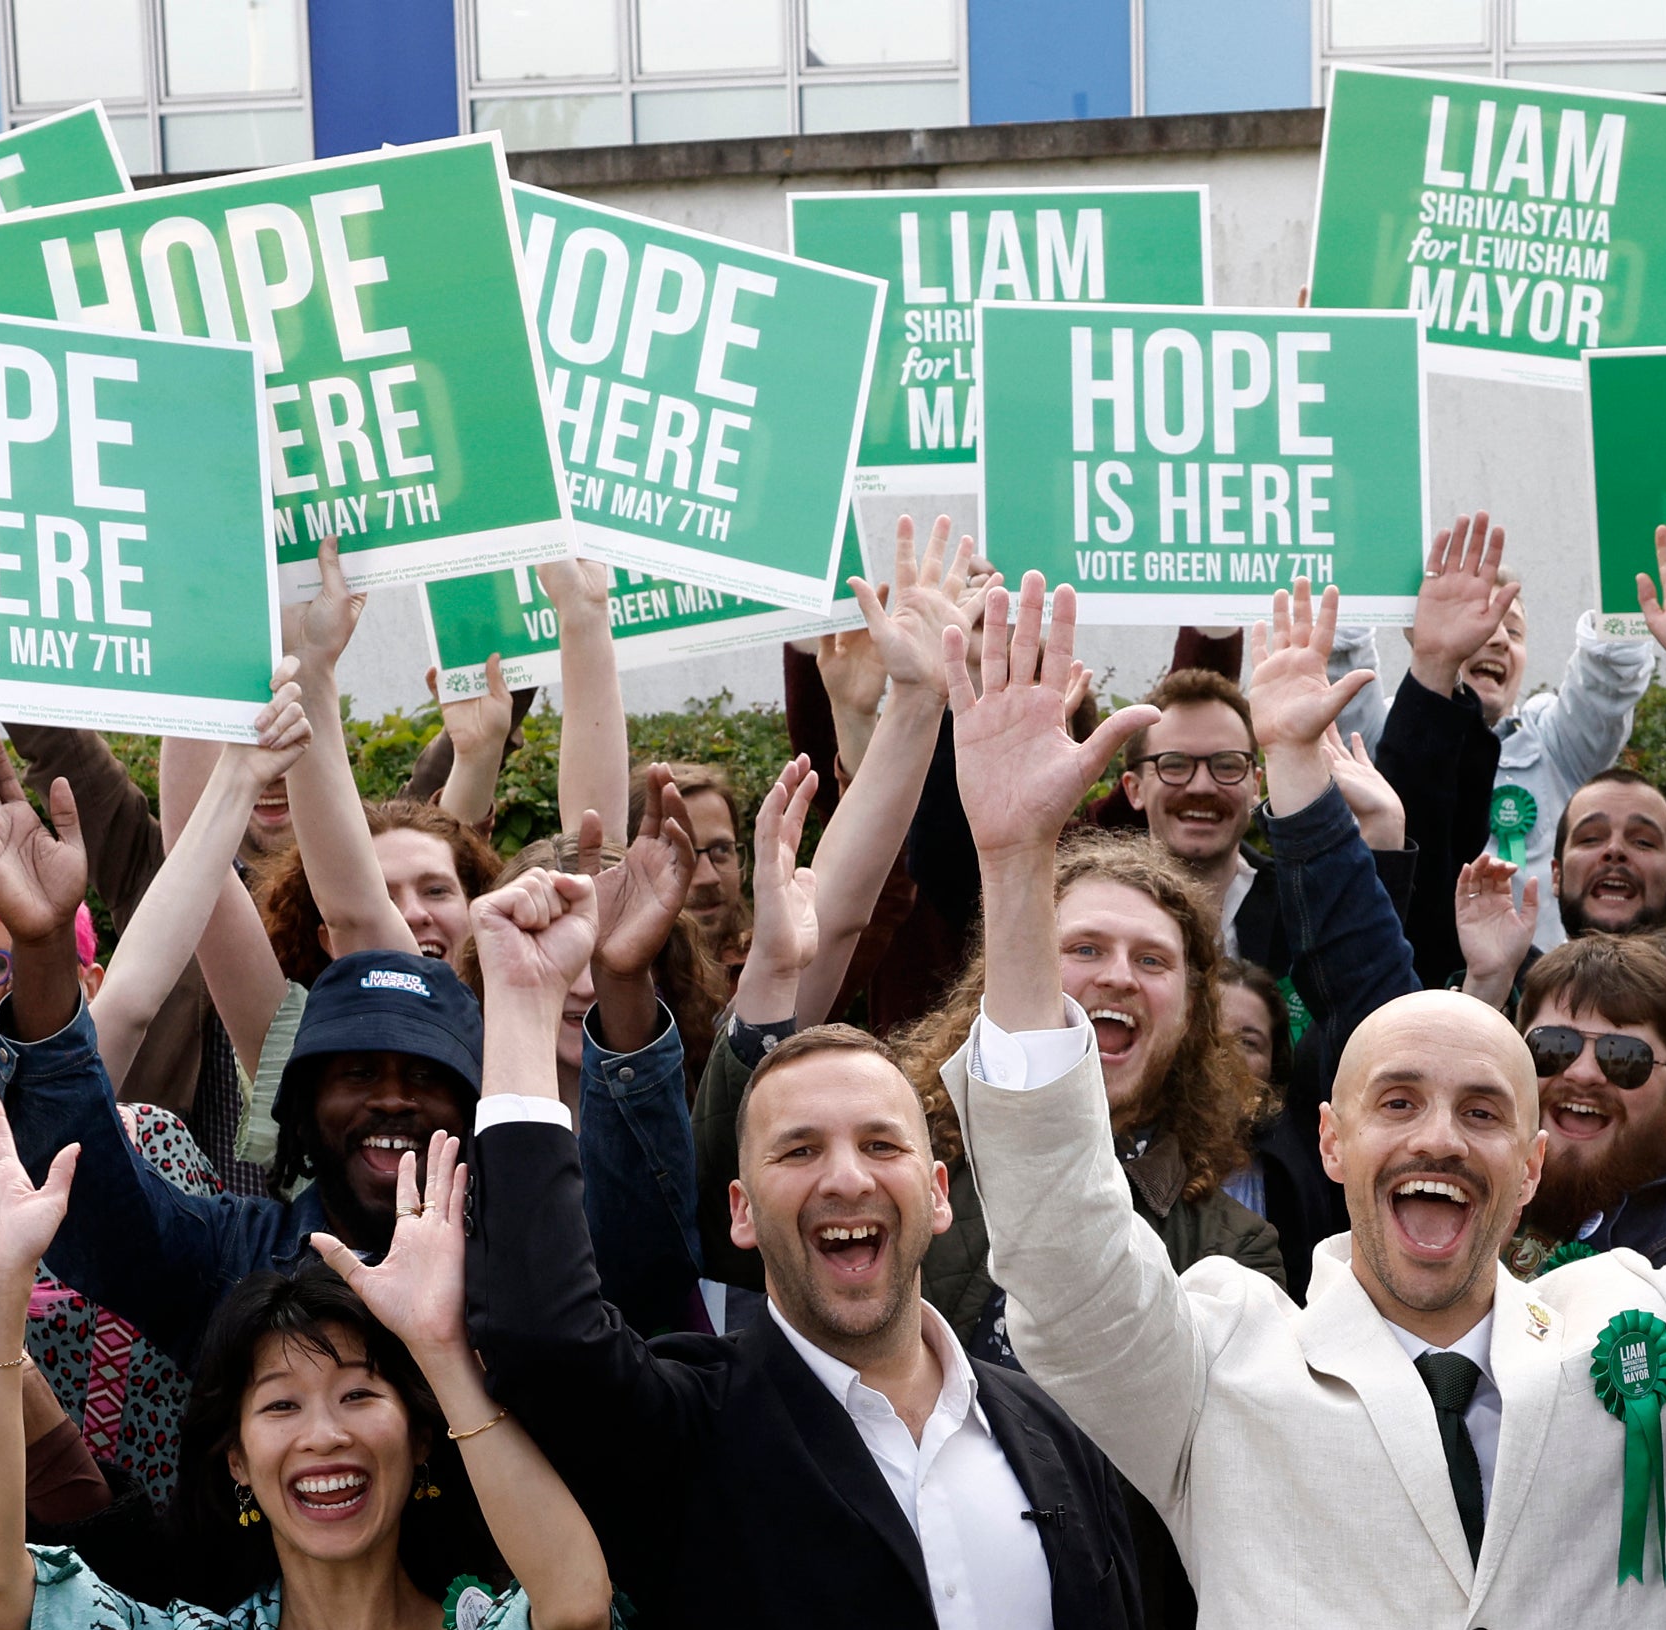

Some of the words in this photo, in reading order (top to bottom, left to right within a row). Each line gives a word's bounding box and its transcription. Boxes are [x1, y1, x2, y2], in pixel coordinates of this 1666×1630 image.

[1424, 95, 1627, 206] LIAM
[1419, 191, 1611, 244] SHRIVASTAVA
[41, 184, 412, 374] HOPE
[900, 207, 1106, 303] LIAM
[1407, 228, 1458, 264] for
[1459, 234, 1609, 283] LEWISHAM
[1408, 266, 1603, 348] MAYOR
[900, 346, 951, 386] for
[1071, 327, 1333, 456] HOPE
[271, 364, 434, 497] ERE
[549, 366, 752, 504] HERE
[307, 492, 369, 544] MAY
[376, 482, 441, 529] 7TH
[610, 483, 672, 527] MAY
[677, 499, 731, 542] 7TH
[861, 483, 887, 491] Party
[1073, 460, 1134, 544] IS
[1159, 461, 1334, 546] HERE
[1075, 551, 1137, 583] VOTE
[1143, 552, 1222, 583] GREEN
[1230, 553, 1281, 583] MAY
[1287, 553, 1333, 584] 7TH
[522, 608, 559, 642] VO
[609, 595, 670, 628] REEN
[11, 626, 78, 670] MAY
[88, 634, 151, 677] 7TH
[506, 672, 533, 686] Party
[1620, 1341, 1647, 1361] LIAM
[1623, 1368, 1650, 1384] MAYOR
